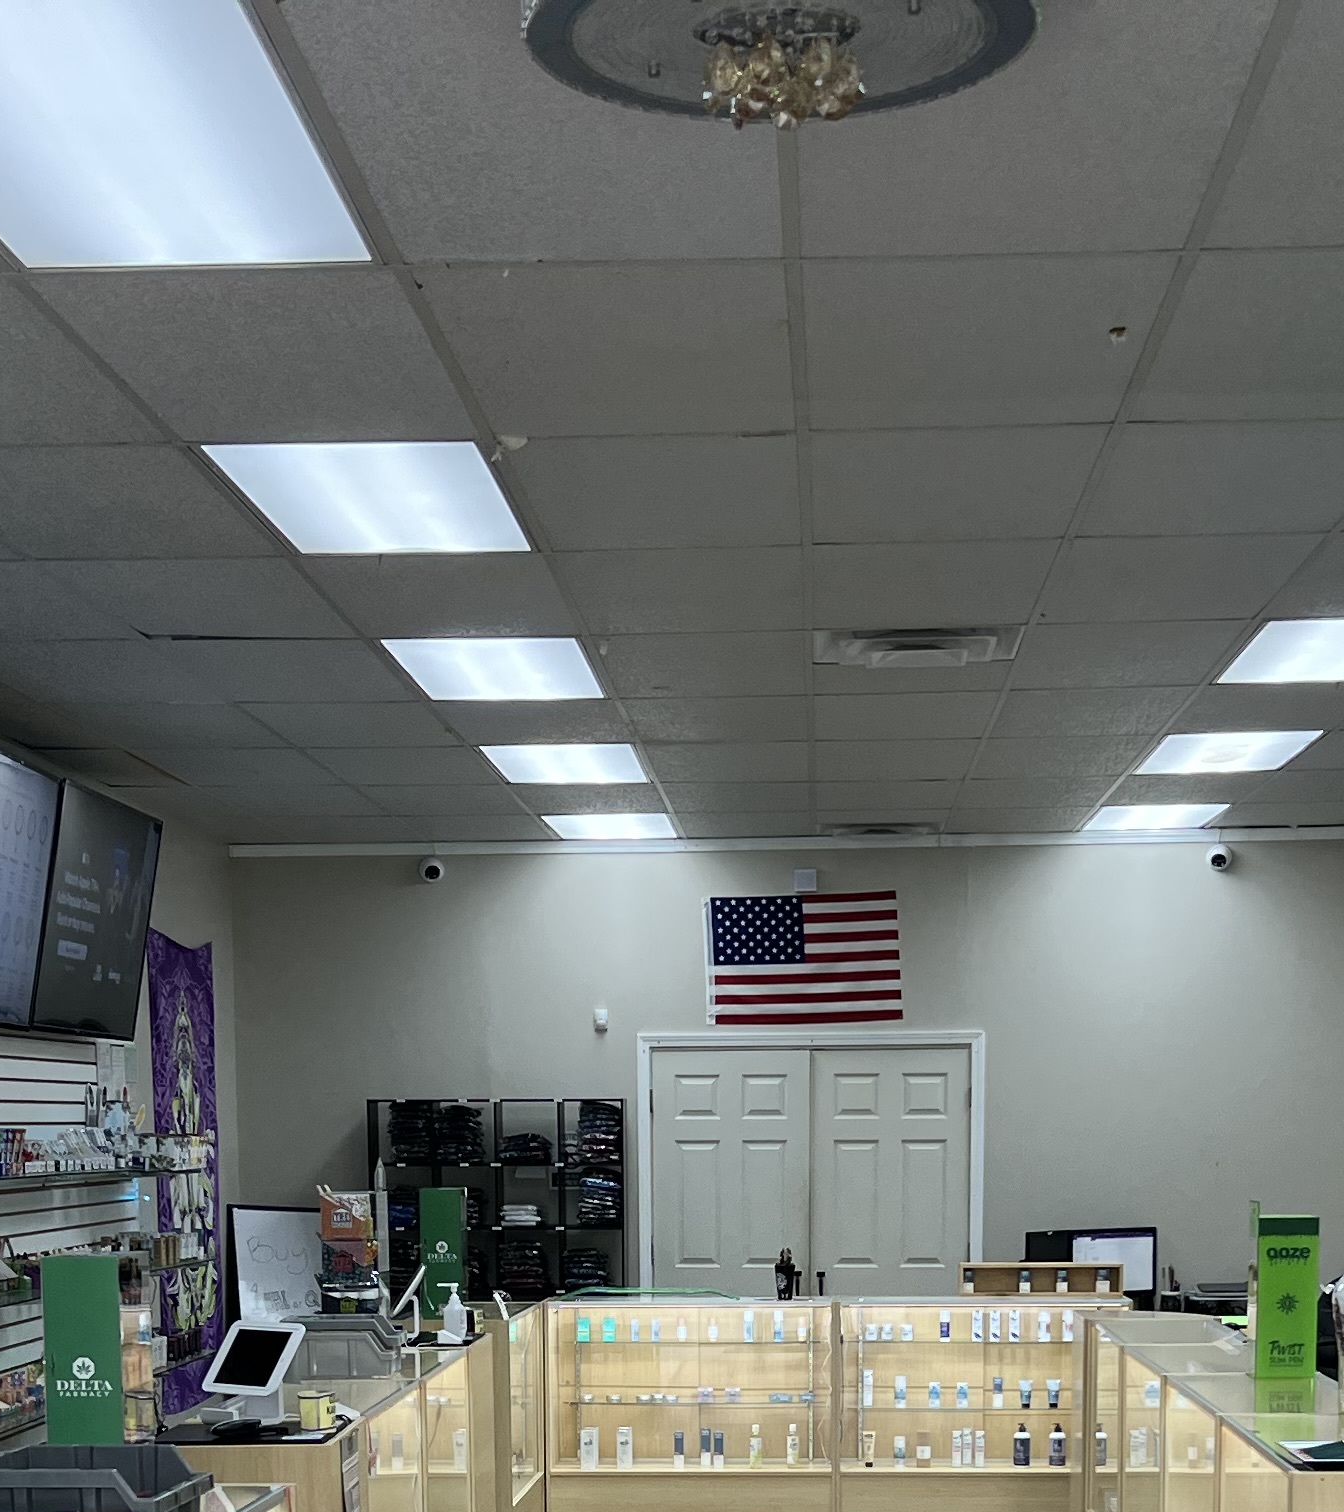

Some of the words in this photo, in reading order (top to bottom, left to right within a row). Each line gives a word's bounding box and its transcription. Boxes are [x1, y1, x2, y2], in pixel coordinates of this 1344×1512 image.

[246, 1235, 309, 1275] Buy
[1266, 1246, 1311, 1261] ooze
[1268, 1339, 1306, 1356] TWIST
[56, 1380, 113, 1391] DELTA
